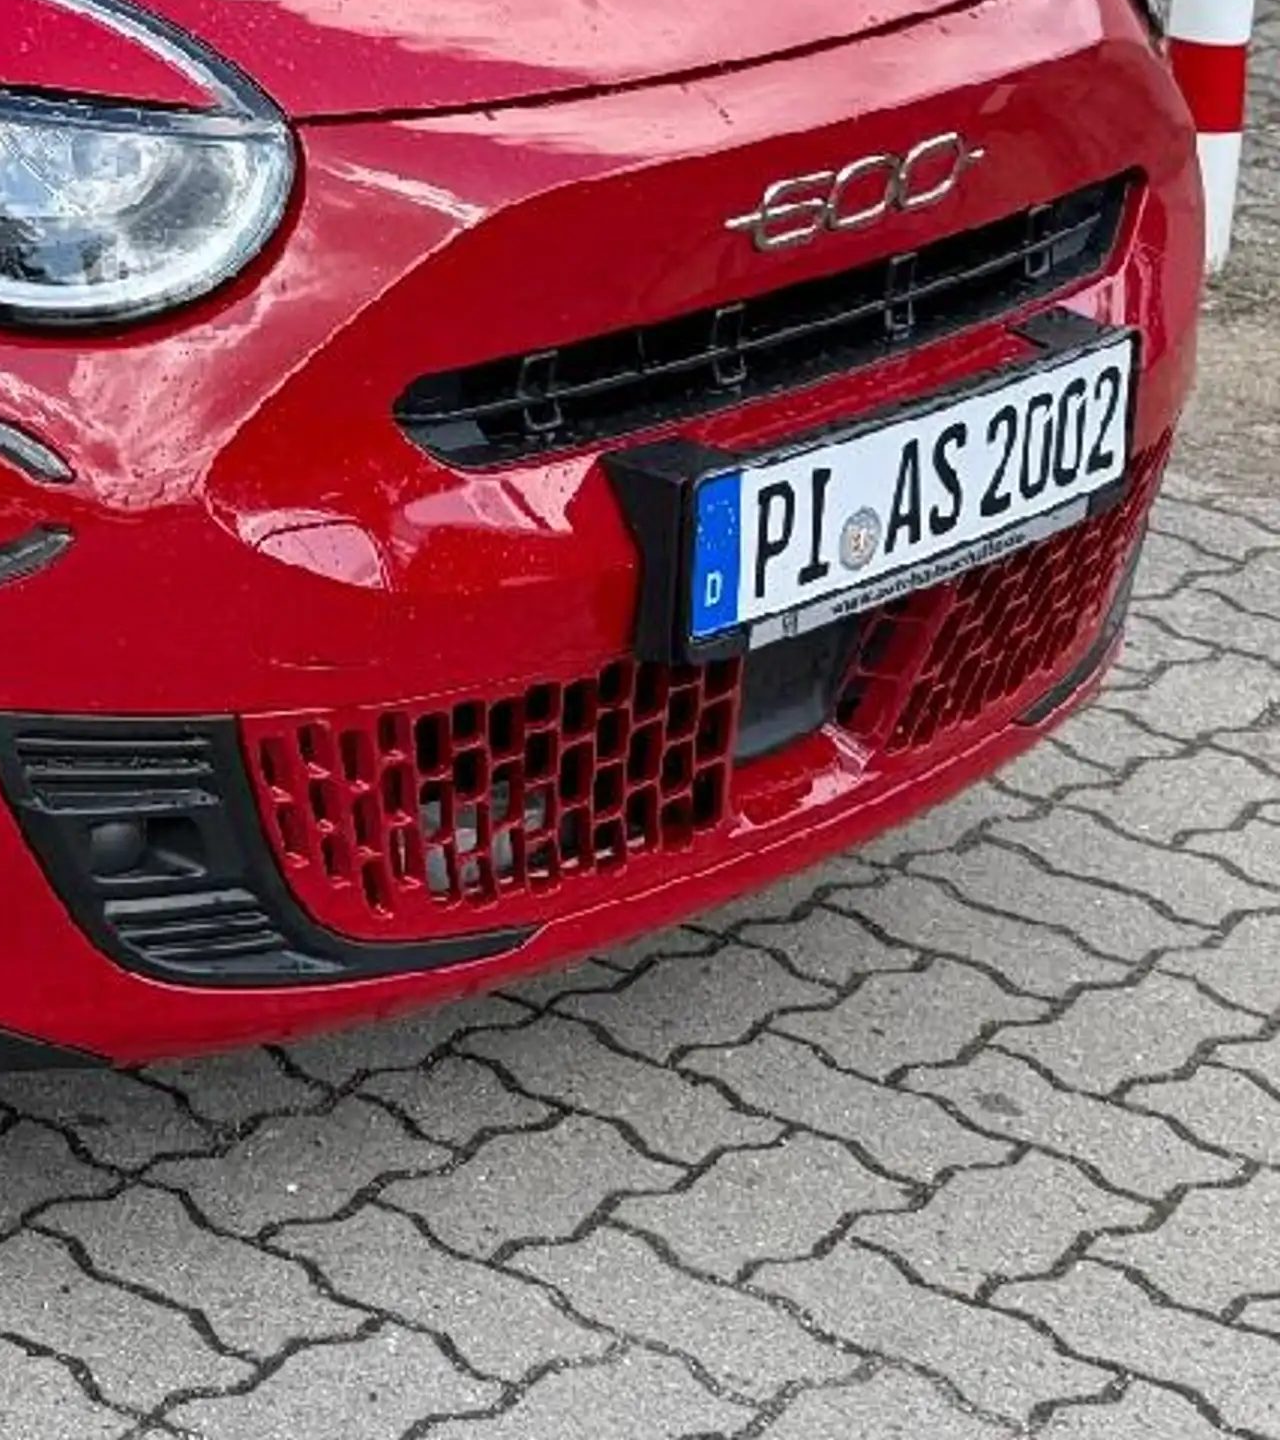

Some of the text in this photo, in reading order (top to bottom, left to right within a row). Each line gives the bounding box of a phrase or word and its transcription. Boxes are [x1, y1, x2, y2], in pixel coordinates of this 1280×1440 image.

[753, 365, 1122, 599] PI AS 2002
[703, 570, 724, 608] D
